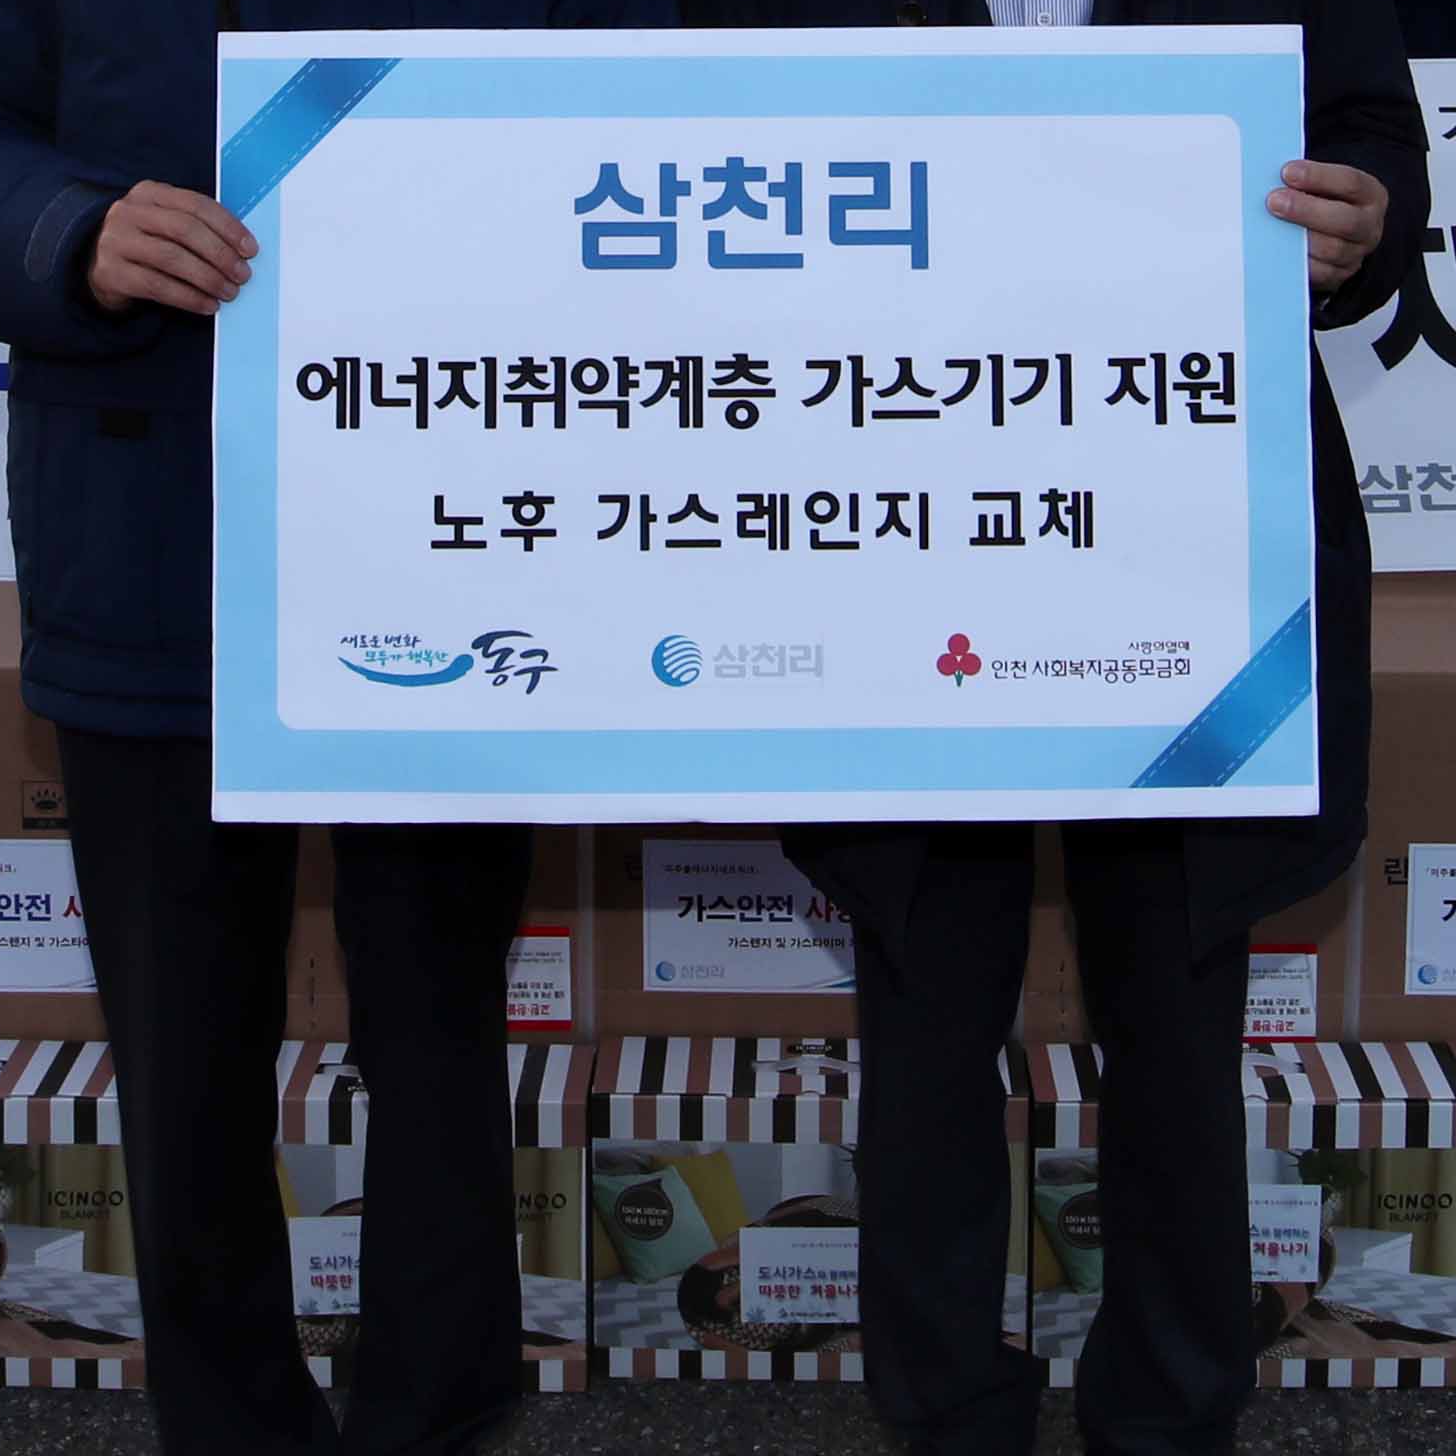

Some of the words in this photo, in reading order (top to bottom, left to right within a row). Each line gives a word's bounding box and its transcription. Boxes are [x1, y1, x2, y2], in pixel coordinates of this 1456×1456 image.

[573, 156, 929, 271] 삼천리
[295, 352, 777, 430] 에너지취약계층
[800, 352, 1076, 428] 가스기기
[1104, 350, 1240, 426] 지원
[430, 489, 558, 552] 노후
[596, 489, 931, 552] 가스레인지
[968, 486, 1097, 550] 교체
[340, 634, 382, 649] 새로운
[383, 633, 422, 649] 변화
[363, 649, 402, 666] 모두가
[407, 649, 449, 667] 행복한
[471, 630, 559, 695] 동구
[712, 642, 824, 678] 삼천리
[991, 659, 1028, 679] 인천
[1031, 657, 1192, 684] 사회복지공동모금회
[677, 894, 794, 922] 가스안전
[757, 1283, 801, 1300] 따뜻한
